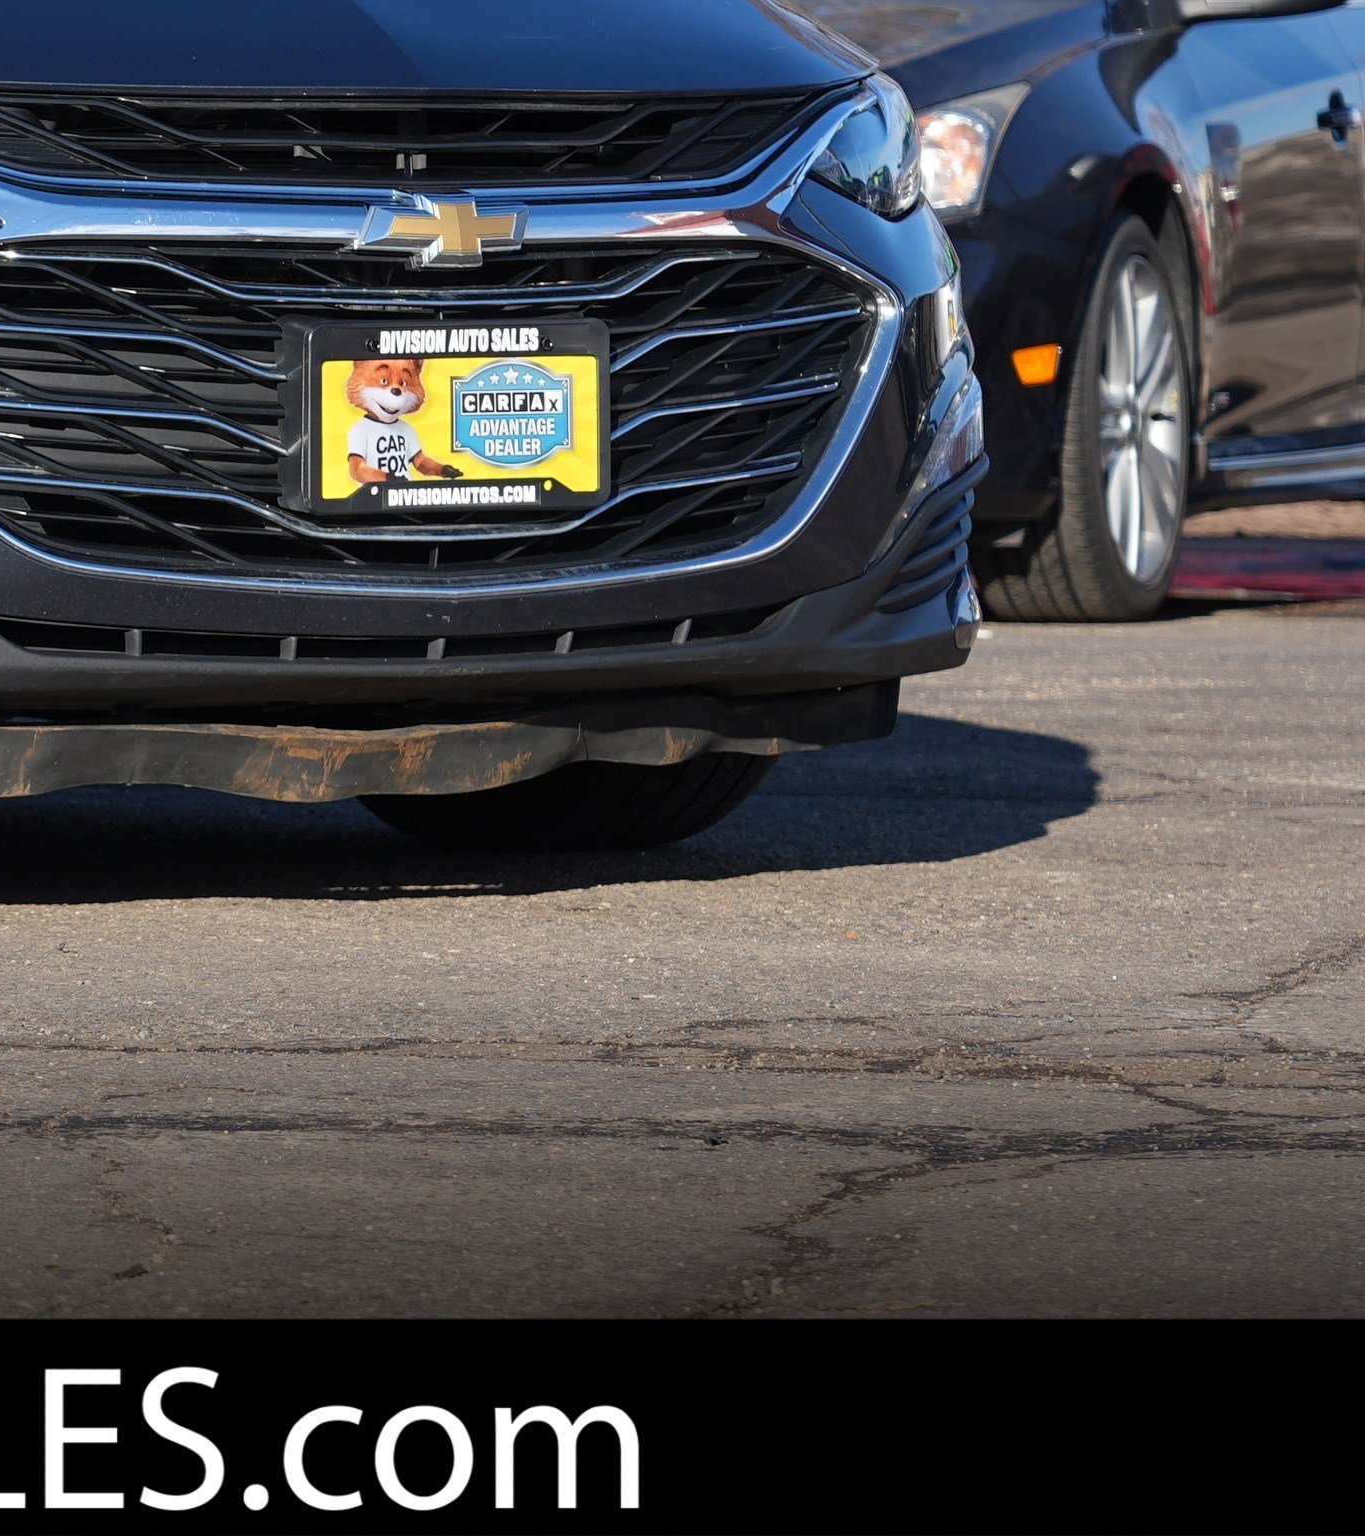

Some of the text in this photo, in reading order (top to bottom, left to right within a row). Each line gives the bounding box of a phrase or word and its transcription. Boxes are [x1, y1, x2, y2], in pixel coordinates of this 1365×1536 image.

[379, 327, 540, 355] DIVISION AUTO SALES
[462, 391, 561, 413] CARFAX
[469, 417, 556, 437] ADVANTAGE
[376, 435, 407, 454] CAR
[484, 438, 542, 457] DEALER
[378, 454, 408, 474] FOX
[387, 485, 537, 507] DIVISIONAUTOS.COM
